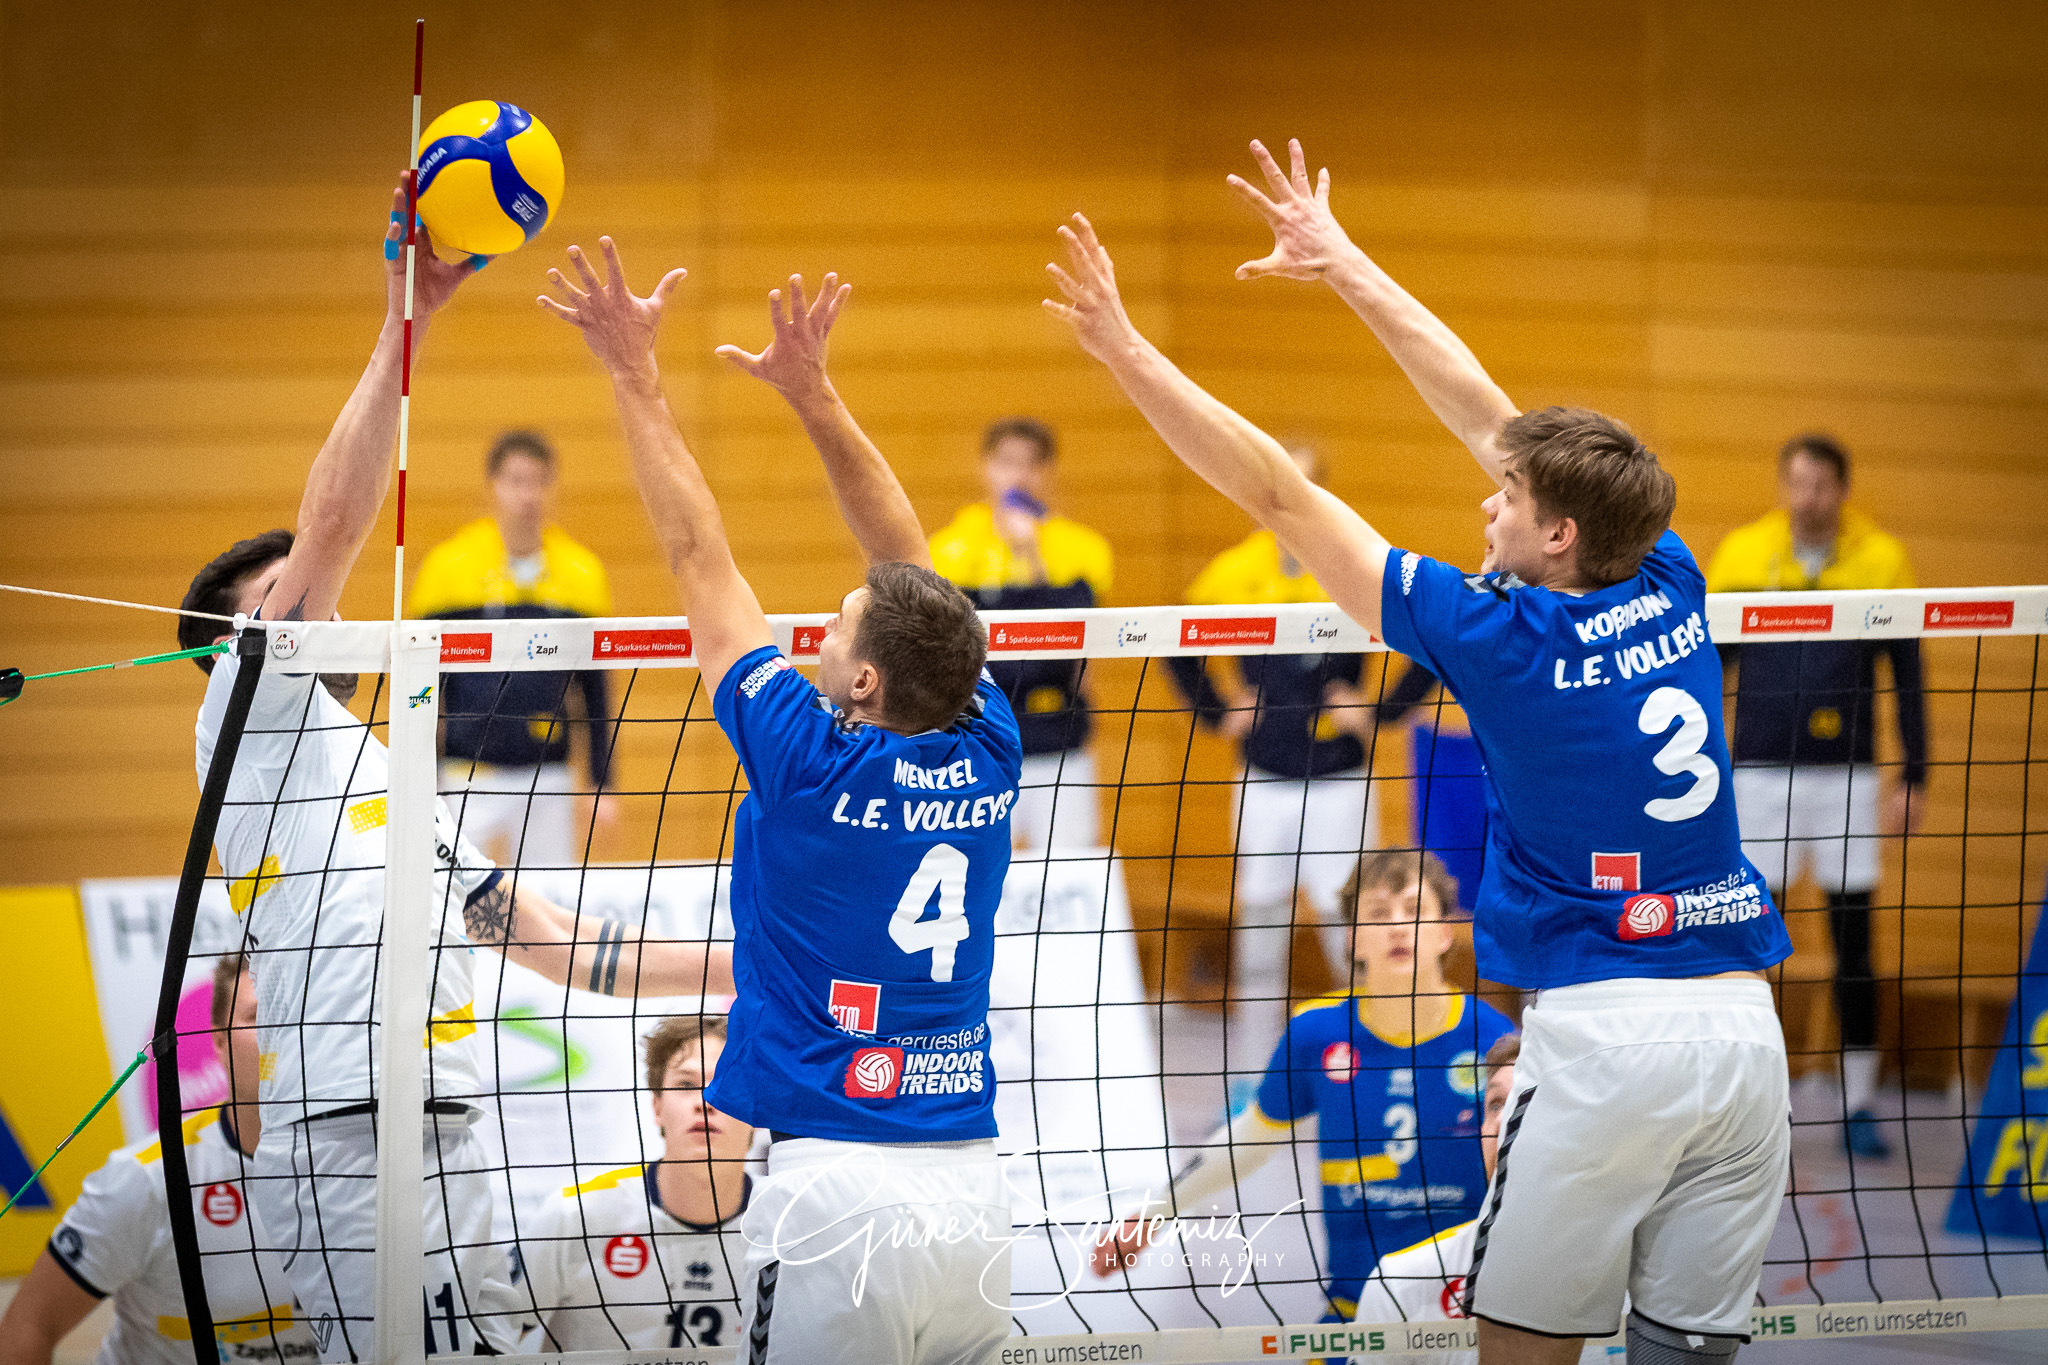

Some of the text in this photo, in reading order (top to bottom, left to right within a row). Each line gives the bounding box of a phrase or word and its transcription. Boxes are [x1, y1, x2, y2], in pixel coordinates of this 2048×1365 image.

[1316, 628, 1338, 639] Zapf
[1871, 616, 1893, 626] Zapf
[613, 642, 686, 653] Sparkasse Nürnberg
[1008, 634, 1079, 645] Sparkasse Nürnberg
[1126, 633, 1148, 643] Zapf
[1200, 629, 1270, 641] Sparkasse Nürnberg
[450, 647, 485, 656] Nürnberg
[535, 645, 559, 655] Zapf
[1554, 611, 1706, 690] L.E. VOLLEYS
[1638, 686, 1720, 822] 3
[893, 757, 978, 790] MENZEL
[832, 789, 1014, 832] L.E. VOLLEYS
[1674, 883, 1761, 915] INDOOR
[888, 843, 970, 982] 4
[1675, 897, 1763, 932] TRENDS
[904, 1050, 984, 1075] INDOOR
[900, 1072, 984, 1095] TRENDS
[1383, 1102, 1418, 1165] 3
[1816, 1311, 1868, 1334] Ideen
[1874, 1309, 1967, 1331] umsetzen
[1001, 1341, 1143, 1365] een umsetzen
[1290, 1331, 1386, 1353] FUCHS
[1406, 1328, 1460, 1350] Ideen
